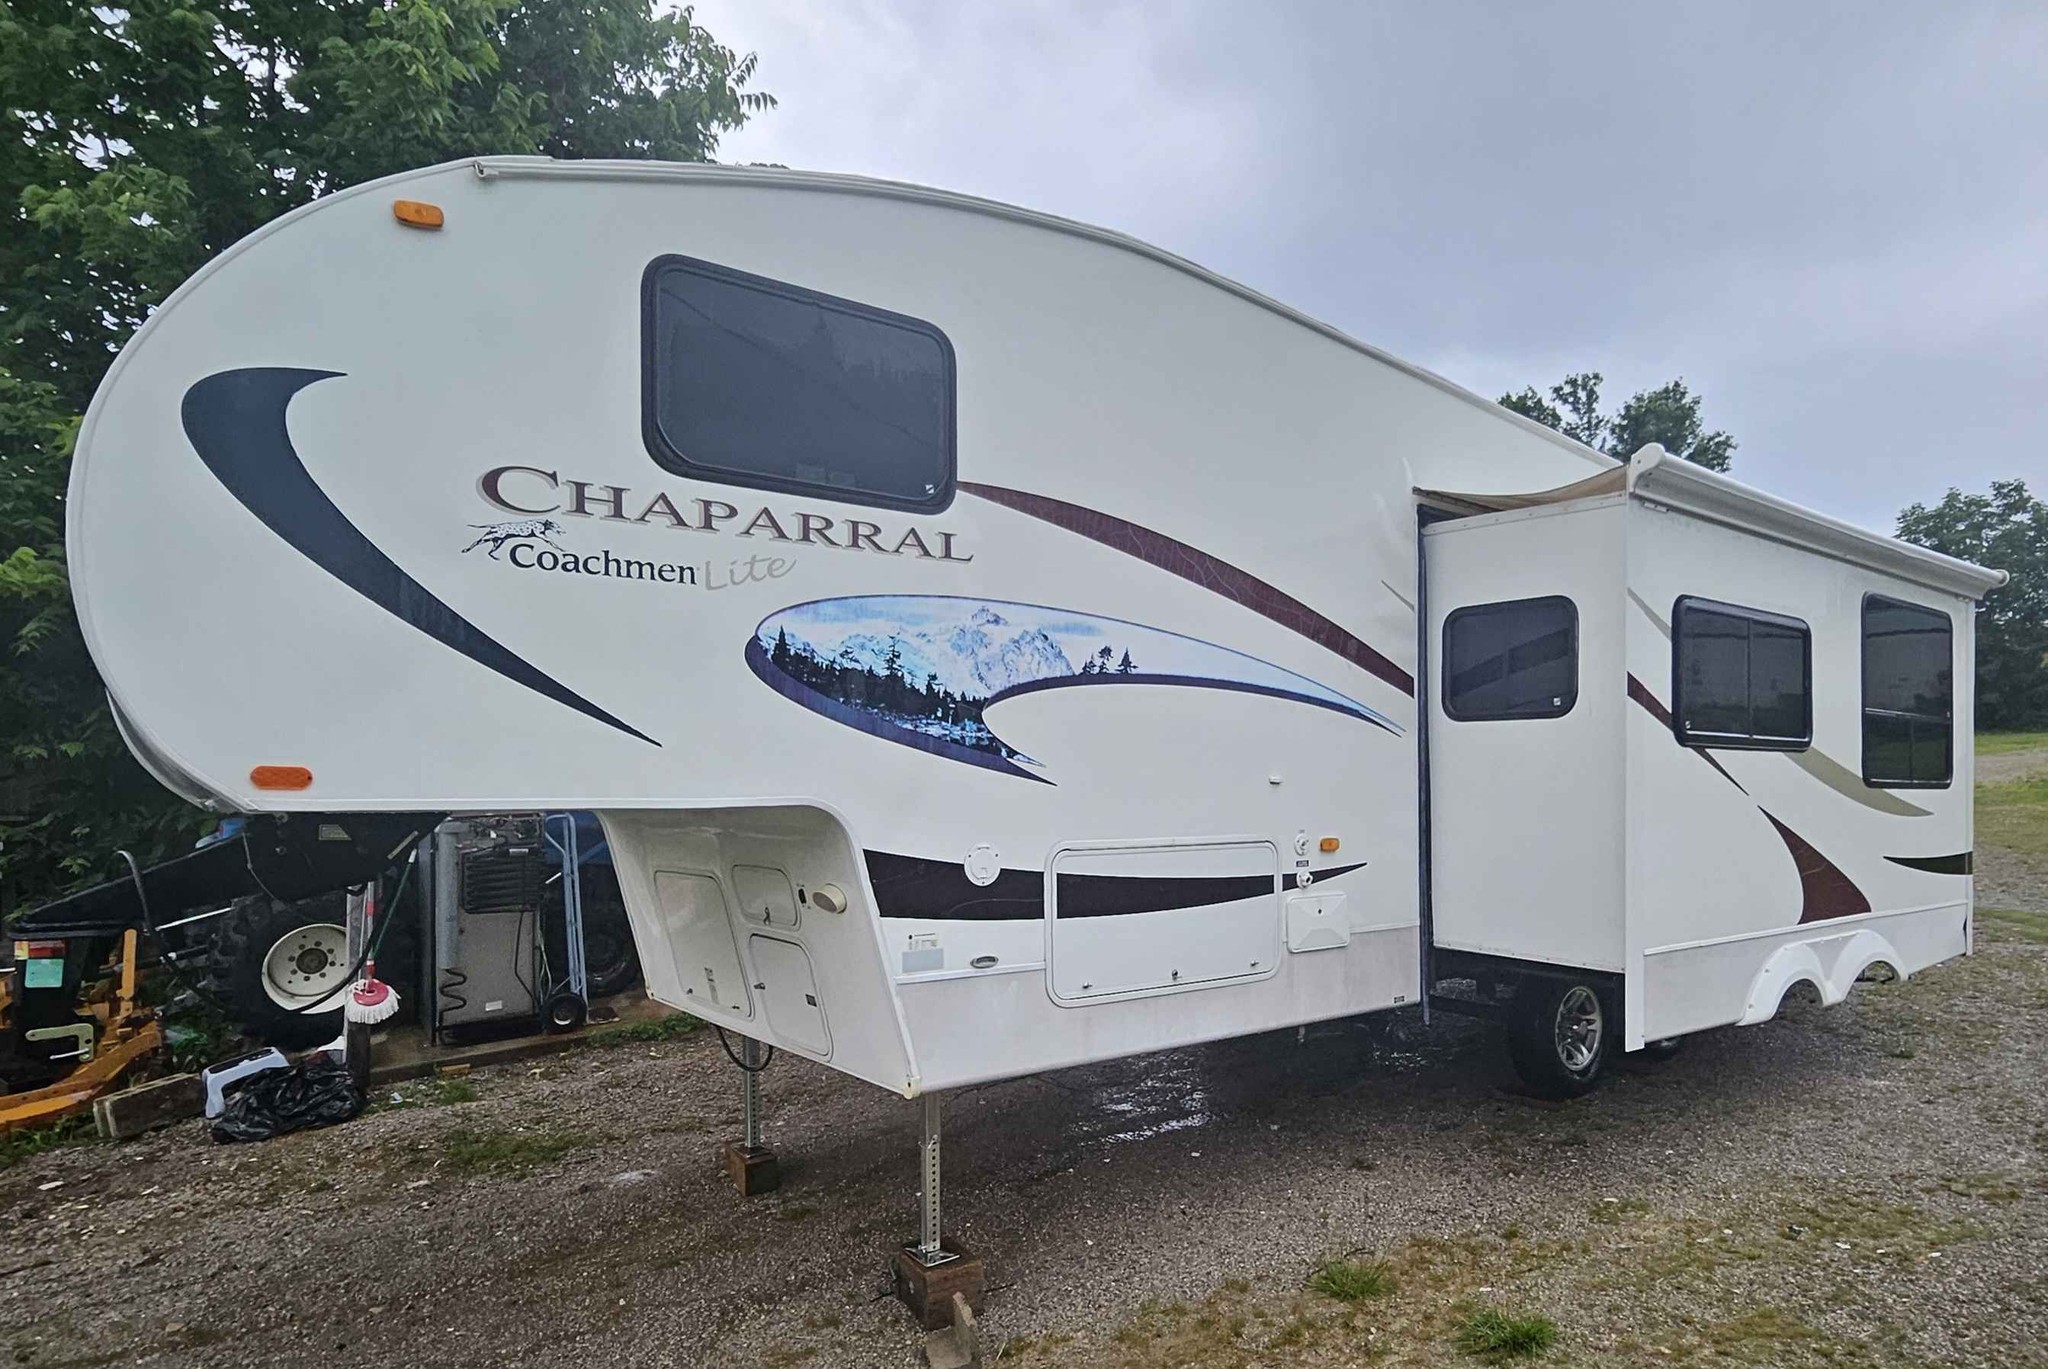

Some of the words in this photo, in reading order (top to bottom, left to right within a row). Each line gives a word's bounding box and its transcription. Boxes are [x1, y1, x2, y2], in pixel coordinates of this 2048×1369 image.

[476, 466, 974, 563] CHAPARRAL
[509, 543, 698, 586] Coachmen
[705, 554, 798, 590] Lite
